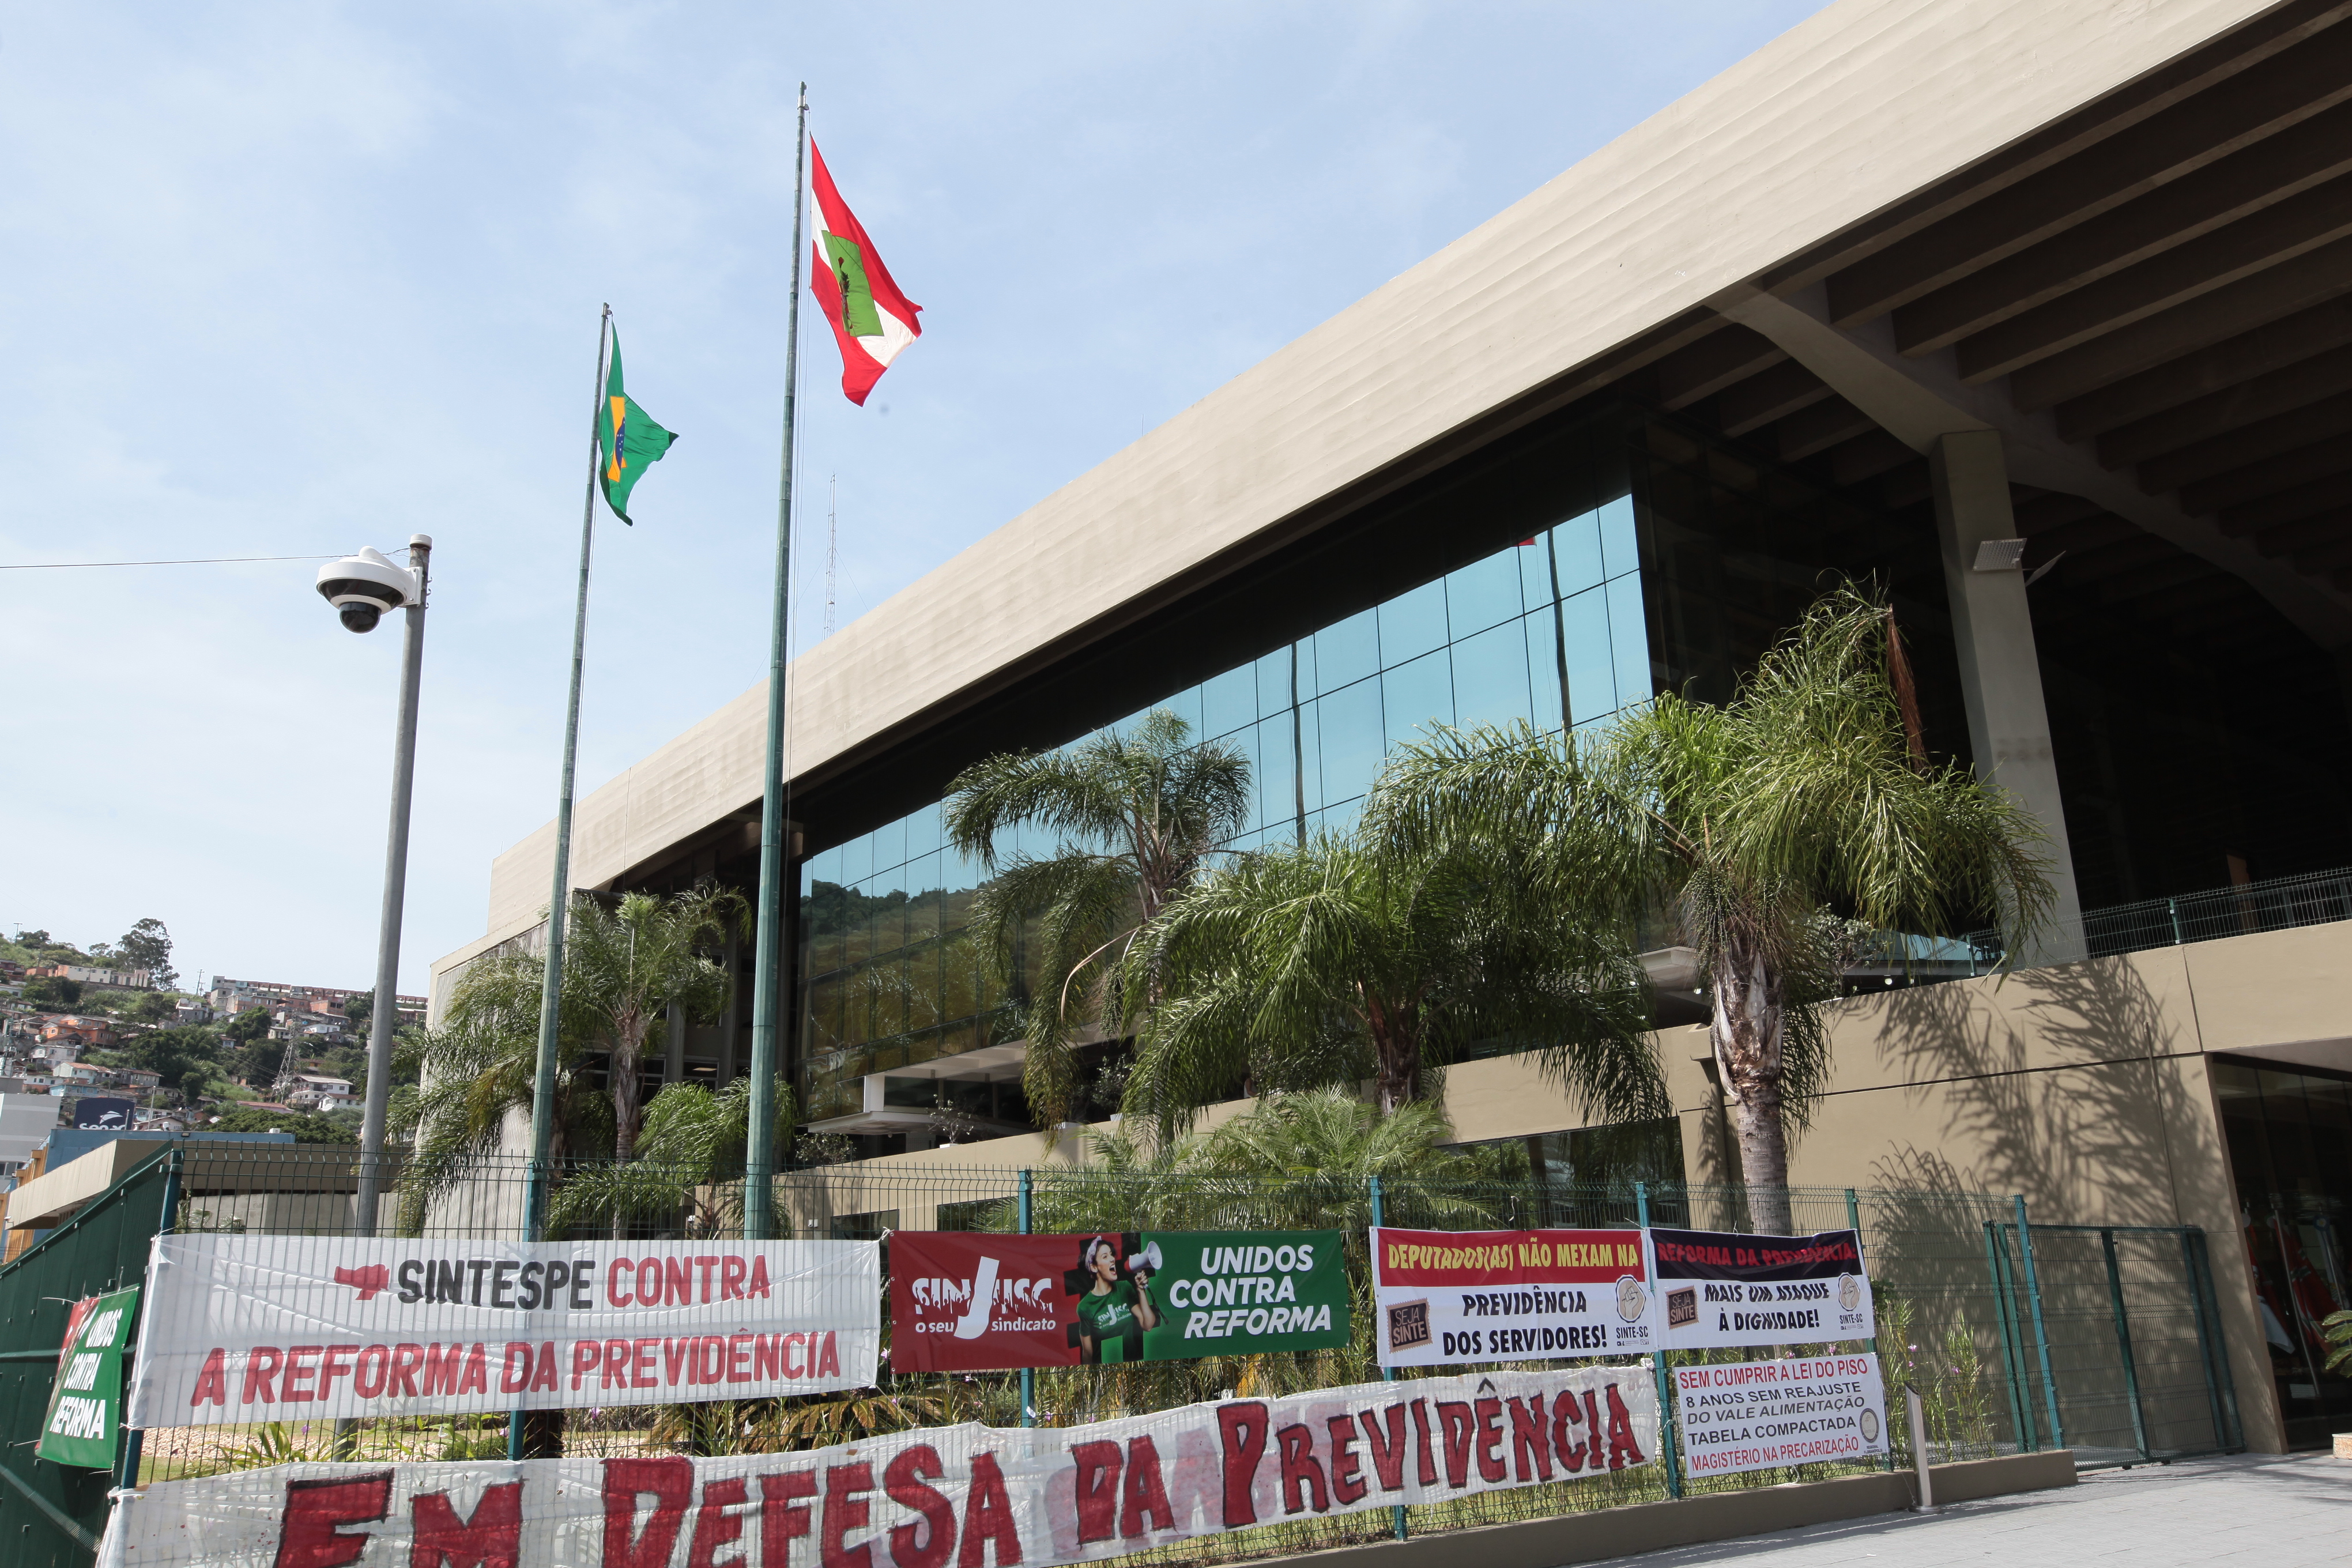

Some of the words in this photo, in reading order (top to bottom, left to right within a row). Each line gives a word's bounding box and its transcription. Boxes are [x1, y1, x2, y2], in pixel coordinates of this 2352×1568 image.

[1201, 1244, 1314, 1276] UNIDOS
[1388, 1244, 1513, 1272] DEPUTADOS(AS)
[1519, 1237, 1552, 1267] NÃO
[1557, 1243, 1614, 1267] MEXAM
[1617, 1244, 1638, 1267] NA
[1657, 1243, 1732, 1265] REFORMA
[1736, 1247, 1758, 1267] DA
[398, 1259, 595, 1310] SINTESPE
[607, 1254, 770, 1308] CONTRA
[1169, 1276, 1295, 1309] CONTRA
[1705, 1284, 1742, 1302] MAIS
[1749, 1286, 1773, 1302] UM
[1777, 1283, 1830, 1302] ATAQUE
[1462, 1286, 1586, 1316] PREVIDÊNCIA
[1671, 1305, 1694, 1322] SINTE
[1672, 1294, 1691, 1307] SEJA
[86, 1308, 123, 1348] UNIDOS
[915, 1322, 926, 1332] o
[929, 1321, 954, 1333] seu
[991, 1317, 1056, 1332] sindicato
[1184, 1304, 1331, 1339] REFORMA
[1395, 1307, 1421, 1325] SEJA
[1719, 1307, 1729, 1331] À
[1734, 1309, 1820, 1330] DIGNIDADE!
[1840, 1313, 1863, 1324] SINTE-SC
[1393, 1321, 1427, 1344] SINTE
[1443, 1330, 1482, 1356] DOS
[1489, 1324, 1607, 1354] SERVIDORES!
[1616, 1326, 1648, 1339] SINTE-SC
[64, 1352, 102, 1391] CONTRA
[190, 1347, 225, 1407] A
[242, 1342, 488, 1404] REFORMA
[500, 1341, 558, 1393] DA
[571, 1328, 840, 1391] PREVIDÊNCIA
[1679, 1370, 1710, 1389] SEM
[1714, 1366, 1778, 1386] CUMPRIR
[1781, 1365, 1791, 1381] A
[1792, 1363, 1813, 1380] LEI
[1815, 1360, 1834, 1378] DO
[1838, 1358, 1868, 1376] PISO
[1686, 1396, 1695, 1408] 8
[1699, 1392, 1744, 1407] ANOS
[1748, 1389, 1782, 1403] SEM
[1785, 1382, 1861, 1399] REAJUSTE
[1687, 1412, 1710, 1424] DO
[1716, 1407, 1755, 1422] VALE
[1759, 1396, 1865, 1418] ALIMENTAÇÃO
[49, 1396, 105, 1439] REFORMA
[1688, 1427, 1751, 1445] TABELA
[1755, 1416, 1857, 1438] COMPACTADA
[1691, 1446, 1760, 1471] MAGISTÉRIO
[1763, 1446, 1779, 1463] NA
[1780, 1434, 1859, 1459] PRECARIZAÇÃO
[271, 1467, 525, 1568] EM
[601, 1444, 1023, 1568] DEFESA
[1070, 1434, 1177, 1546] DA
[1216, 1377, 1647, 1529] PREVIDÊNCIA
